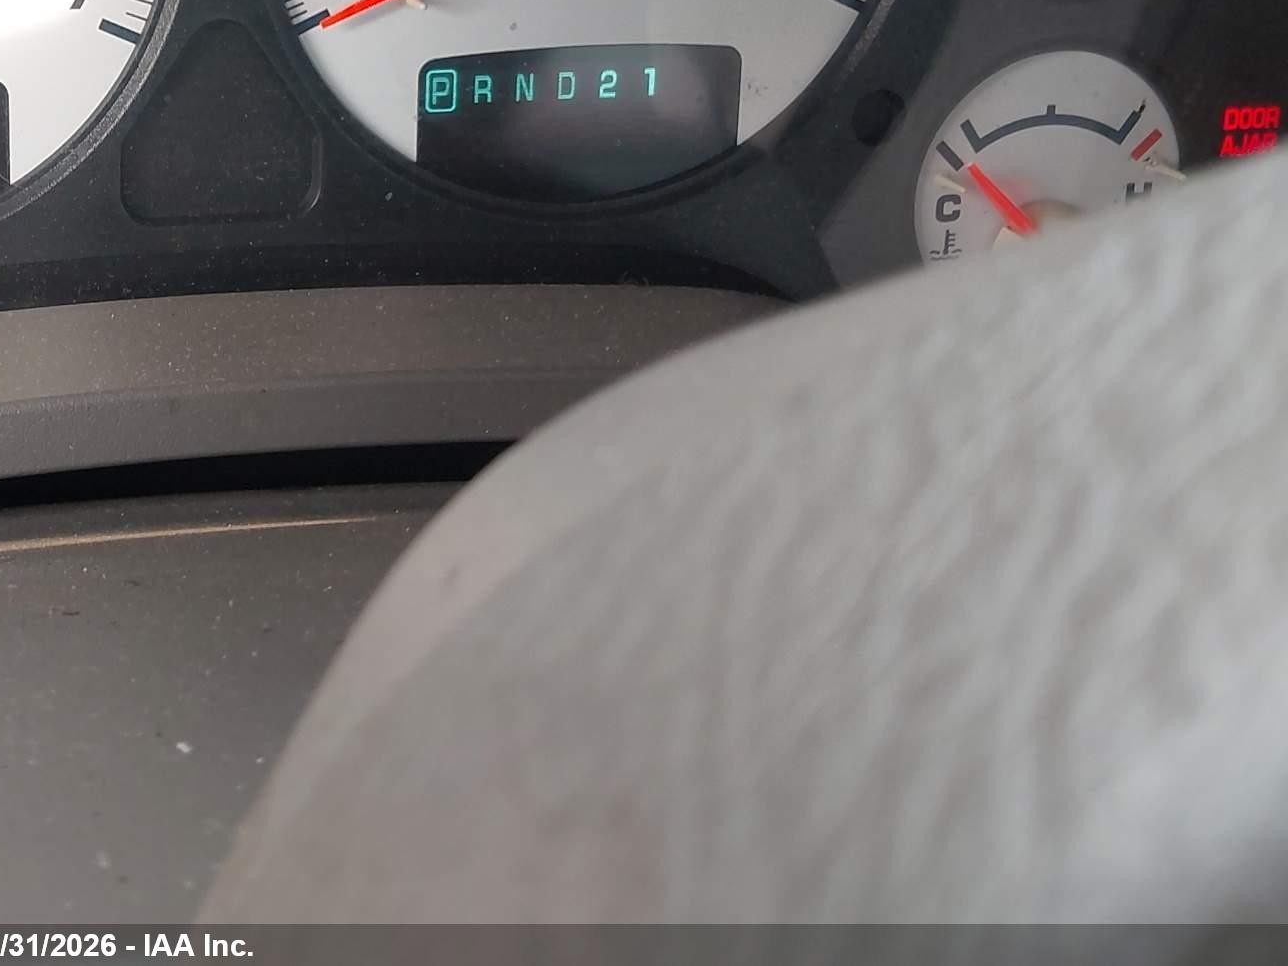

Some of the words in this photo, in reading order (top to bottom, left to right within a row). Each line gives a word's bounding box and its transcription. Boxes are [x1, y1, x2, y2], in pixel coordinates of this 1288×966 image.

[432, 76, 449, 105] P
[474, 75, 492, 103] R
[516, 73, 534, 101] N
[558, 71, 575, 100] D
[599, 70, 617, 99] 2
[644, 67, 656, 96] 1
[1223, 105, 1281, 130] DOOR
[935, 194, 961, 223] C
